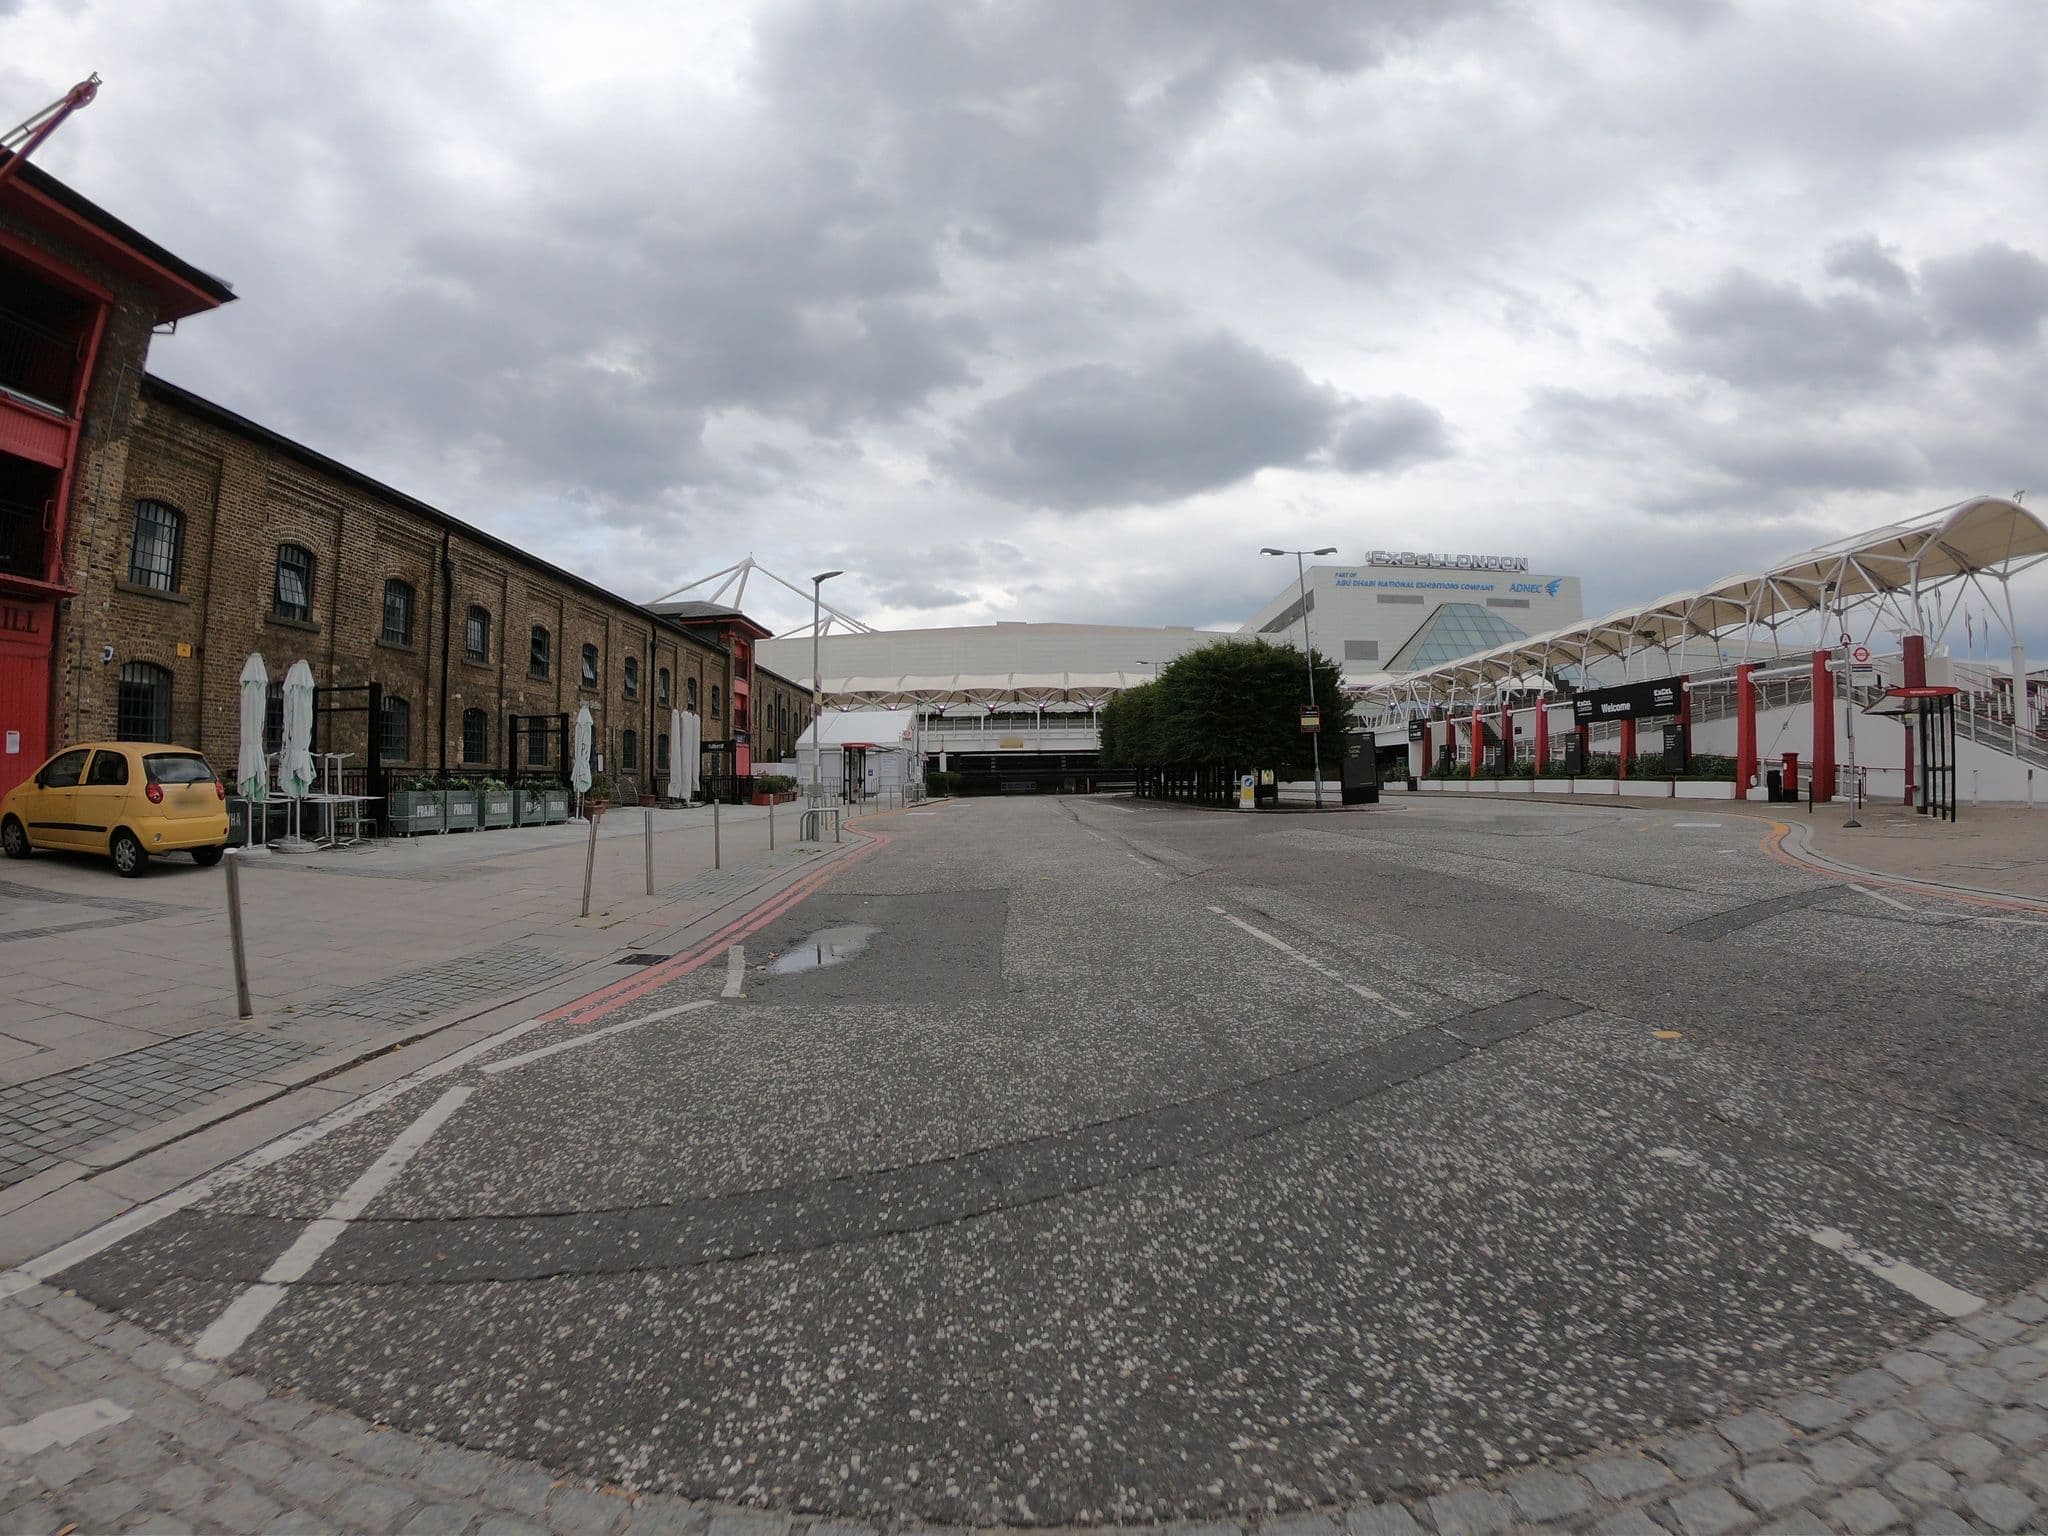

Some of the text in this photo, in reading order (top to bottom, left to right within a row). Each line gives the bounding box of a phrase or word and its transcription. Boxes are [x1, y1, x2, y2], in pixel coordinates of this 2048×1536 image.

[1445, 553, 1529, 569] LONDON
[1377, 580, 1414, 588] NATIONAL
[1416, 581, 1459, 590] EXHIBITIONS
[1460, 583, 1495, 591] COMPANY
[1509, 583, 1542, 593] ADNEC
[1601, 702, 1631, 713] Welcome
